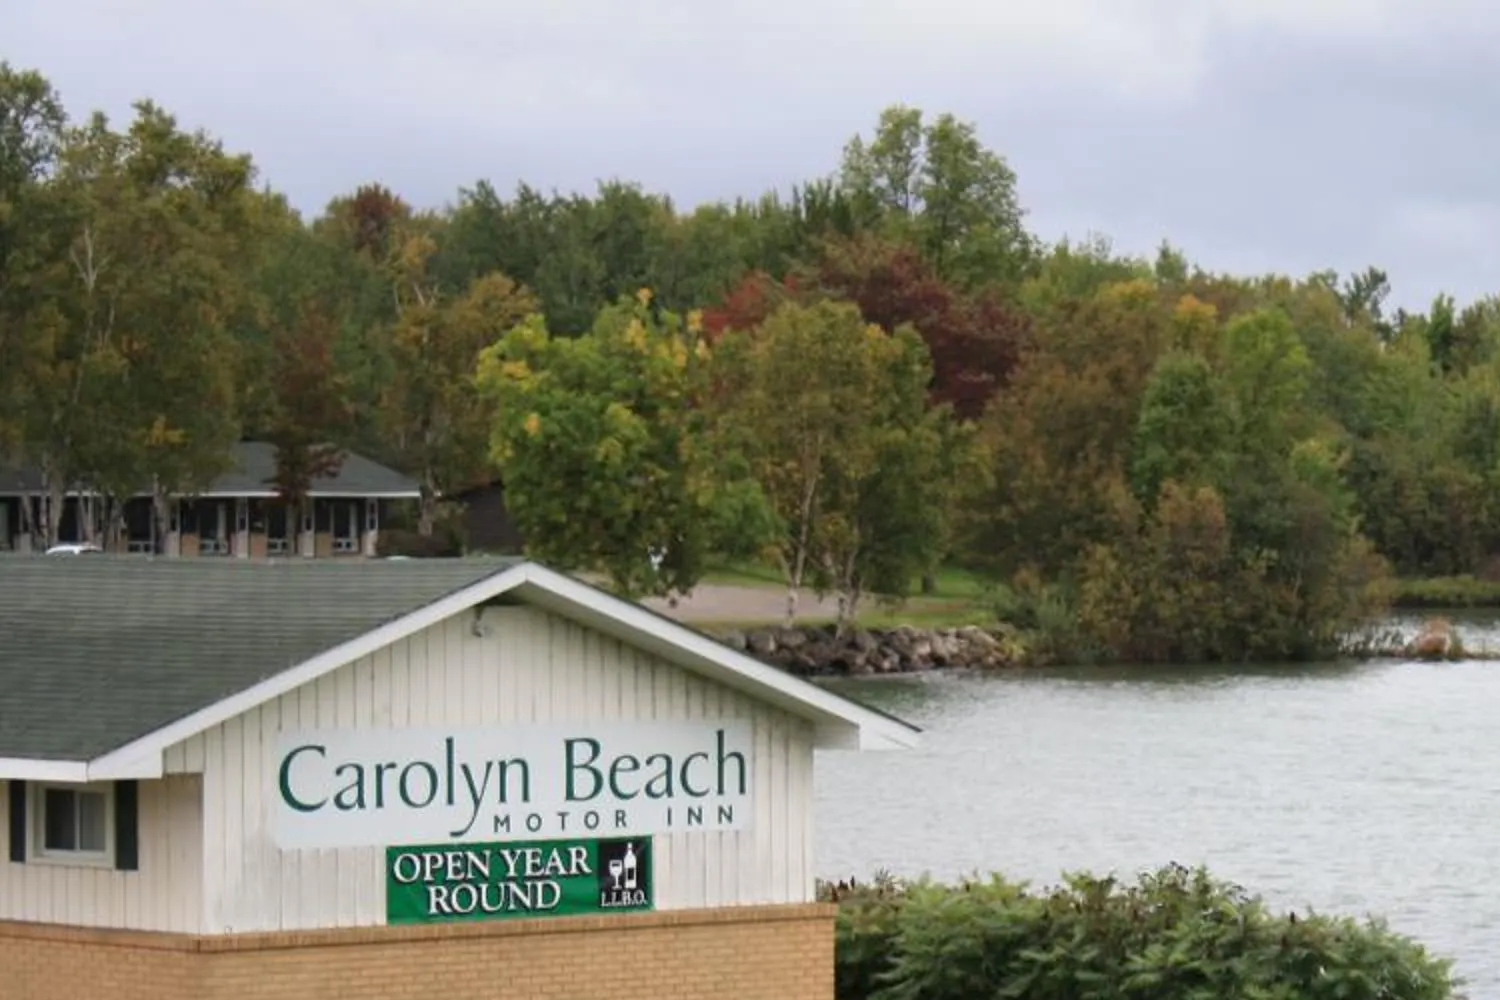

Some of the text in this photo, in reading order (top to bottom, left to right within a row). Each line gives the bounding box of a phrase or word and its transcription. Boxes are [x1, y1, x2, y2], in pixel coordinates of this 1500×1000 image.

[278, 728, 748, 837] Carolyn Beach
[493, 804, 733, 834] MOTOR INN
[393, 846, 592, 883] OPEN YEAR
[428, 880, 561, 915] ROUND
